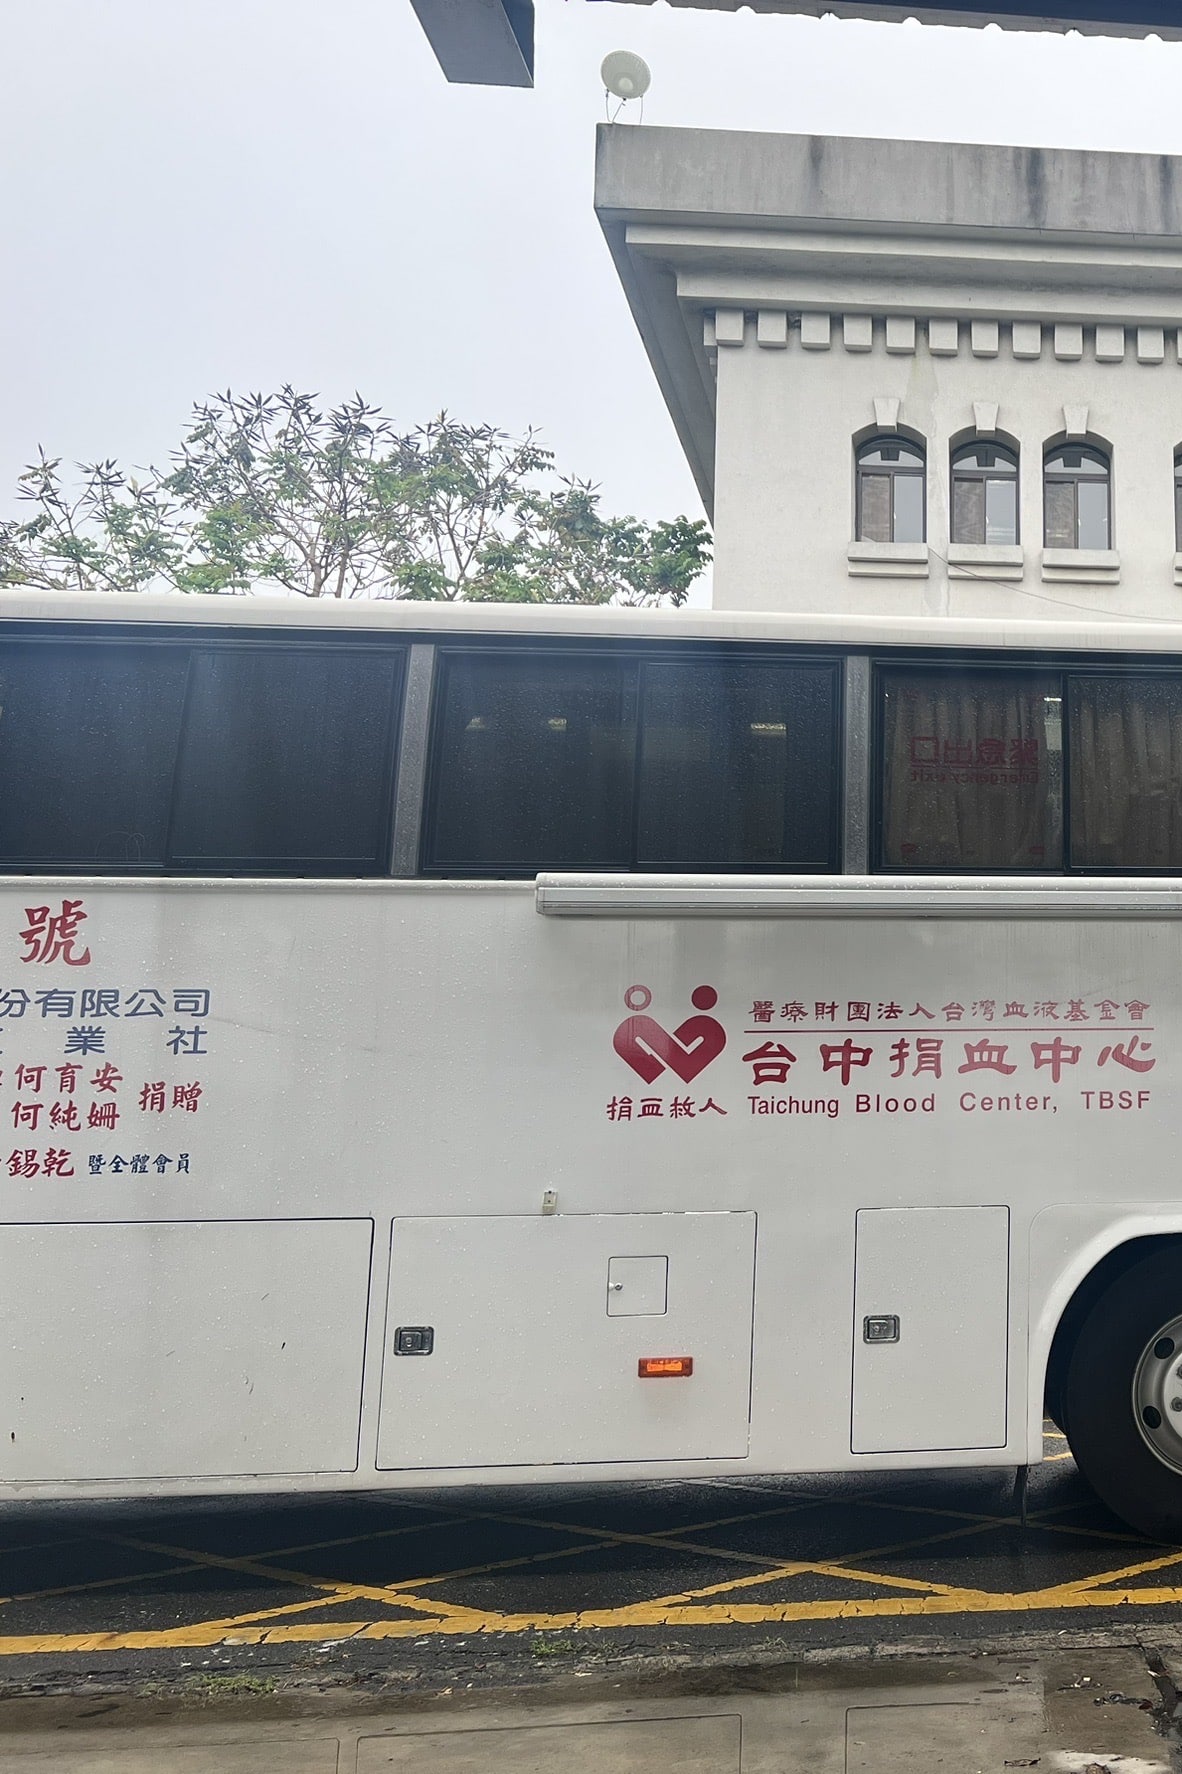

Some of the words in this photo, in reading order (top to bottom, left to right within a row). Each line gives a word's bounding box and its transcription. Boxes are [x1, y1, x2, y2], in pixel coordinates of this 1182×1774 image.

[19, 900, 91, 966] 號
[749, 1000, 1151, 1023] 醫療財團法人台灣血液基金會
[742, 1035, 1156, 1086] 台中捐血中心
[0, 1062, 123, 1094] 何育安
[138, 1081, 203, 1113] 捐贈
[606, 1096, 728, 1121] 捐血救人
[747, 1096, 839, 1118] Taichung
[855, 1093, 935, 1113] Blood
[959, 1092, 1058, 1114] Center,
[1080, 1090, 1151, 1110] TBSF
[11, 1100, 120, 1131] 何純姍
[0, 1147, 74, 1178] 錫乾
[88, 1153, 190, 1175] 暨全體會員
